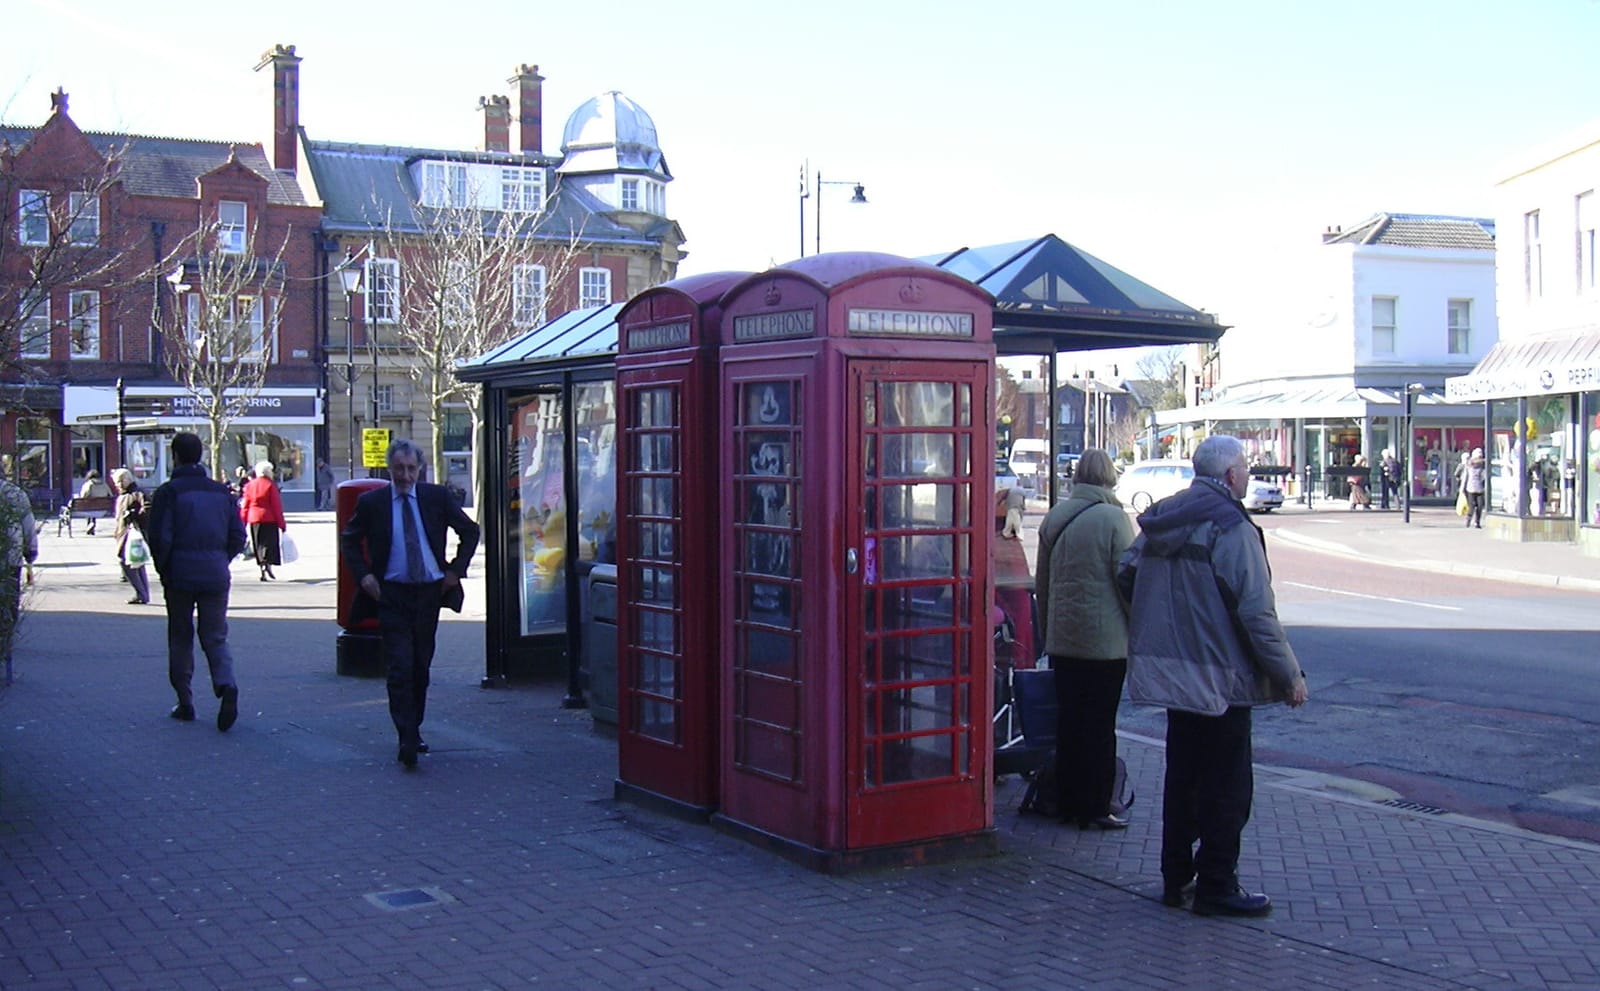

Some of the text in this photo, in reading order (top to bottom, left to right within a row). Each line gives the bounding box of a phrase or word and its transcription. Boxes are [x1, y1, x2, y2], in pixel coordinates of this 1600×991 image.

[737, 312, 812, 337] TELEPHONE
[853, 311, 969, 336] TELEPHONE
[173, 397, 222, 407] HIDDE
